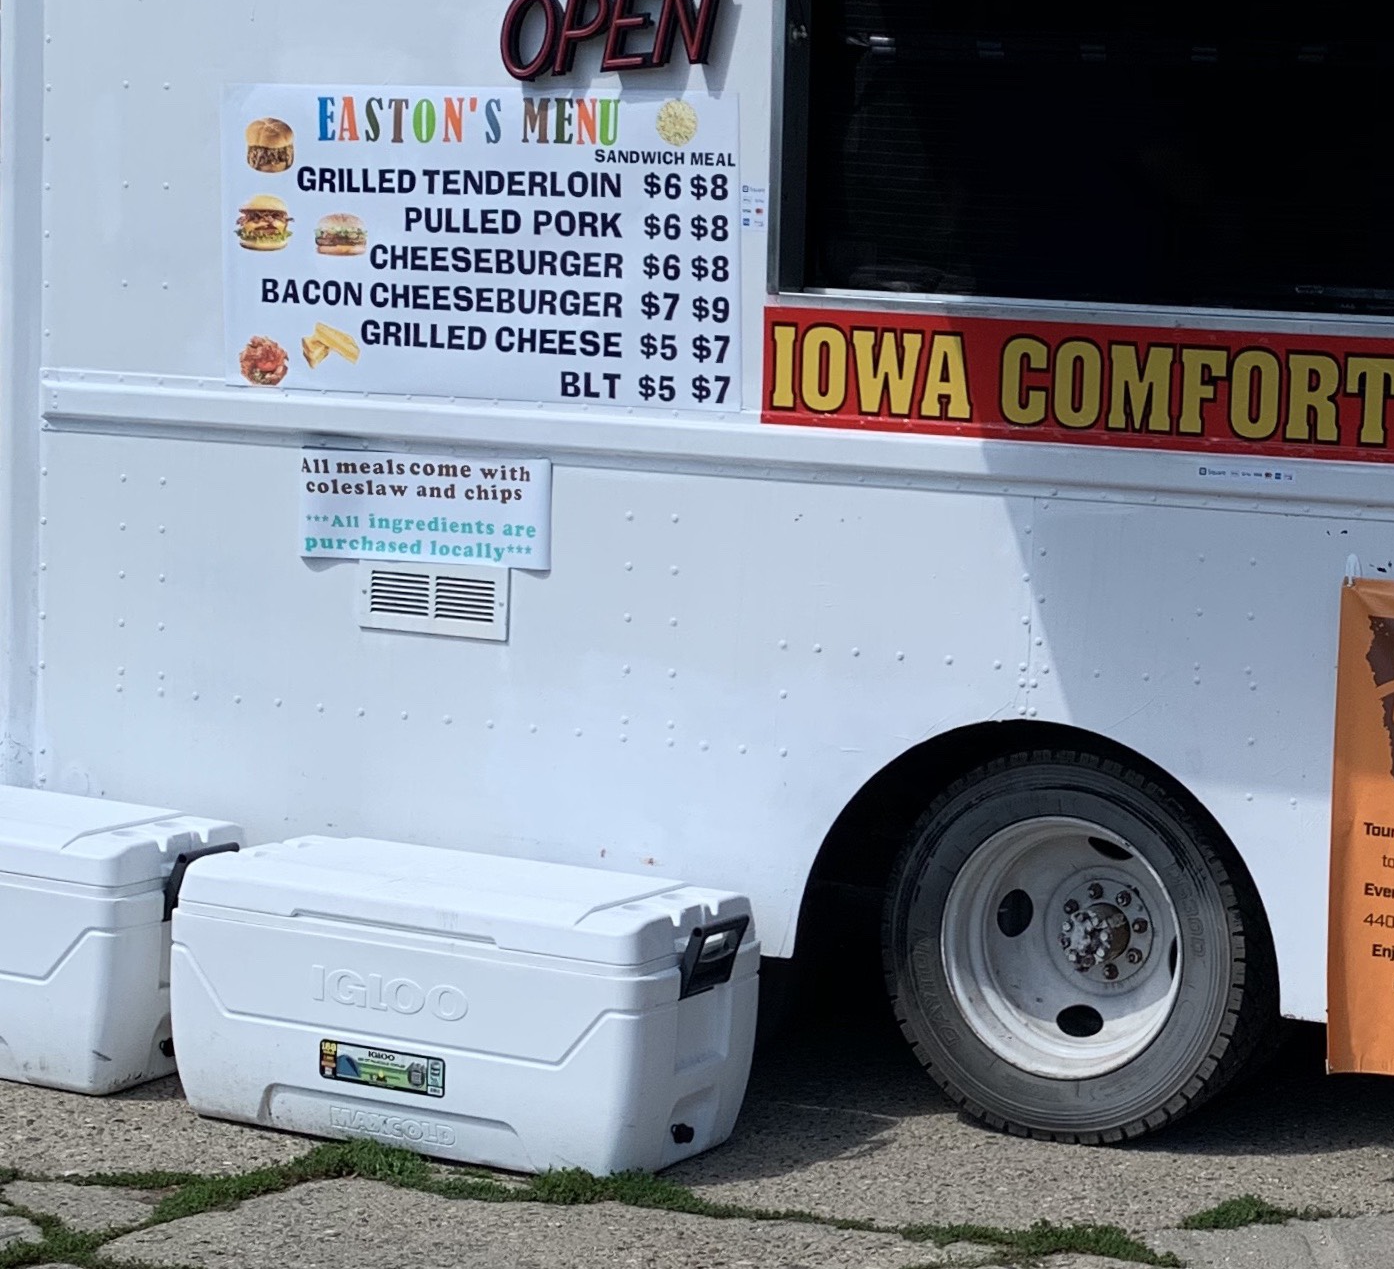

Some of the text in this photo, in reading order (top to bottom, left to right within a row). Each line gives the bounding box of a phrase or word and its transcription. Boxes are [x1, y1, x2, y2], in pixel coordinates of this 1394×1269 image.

[316, 96, 621, 146] EASTON'S MENU
[595, 148, 736, 168] SANDWICH MEAL
[297, 166, 729, 202] GRILLED TENDERLOIN $6 $8
[405, 207, 729, 243] PULLED PORK $6 $8
[369, 244, 730, 283] CHEESEBURGER $6 $8
[262, 278, 730, 324] BACON CHEESEBURGER $7 $9
[360, 320, 731, 364] GRILLED CHEESE $5 $7
[560, 371, 731, 404] BLT $5 $7
[771, 324, 973, 420] IOWA
[301, 456, 531, 483] All meals come with
[306, 478, 523, 504] coleslaw and chips
[369, 513, 495, 536] ingredients
[502, 522, 537, 538] are
[304, 535, 422, 555] purchased
[311, 964, 468, 1022] IGLOO
[368, 1050, 395, 1061] IGLOO
